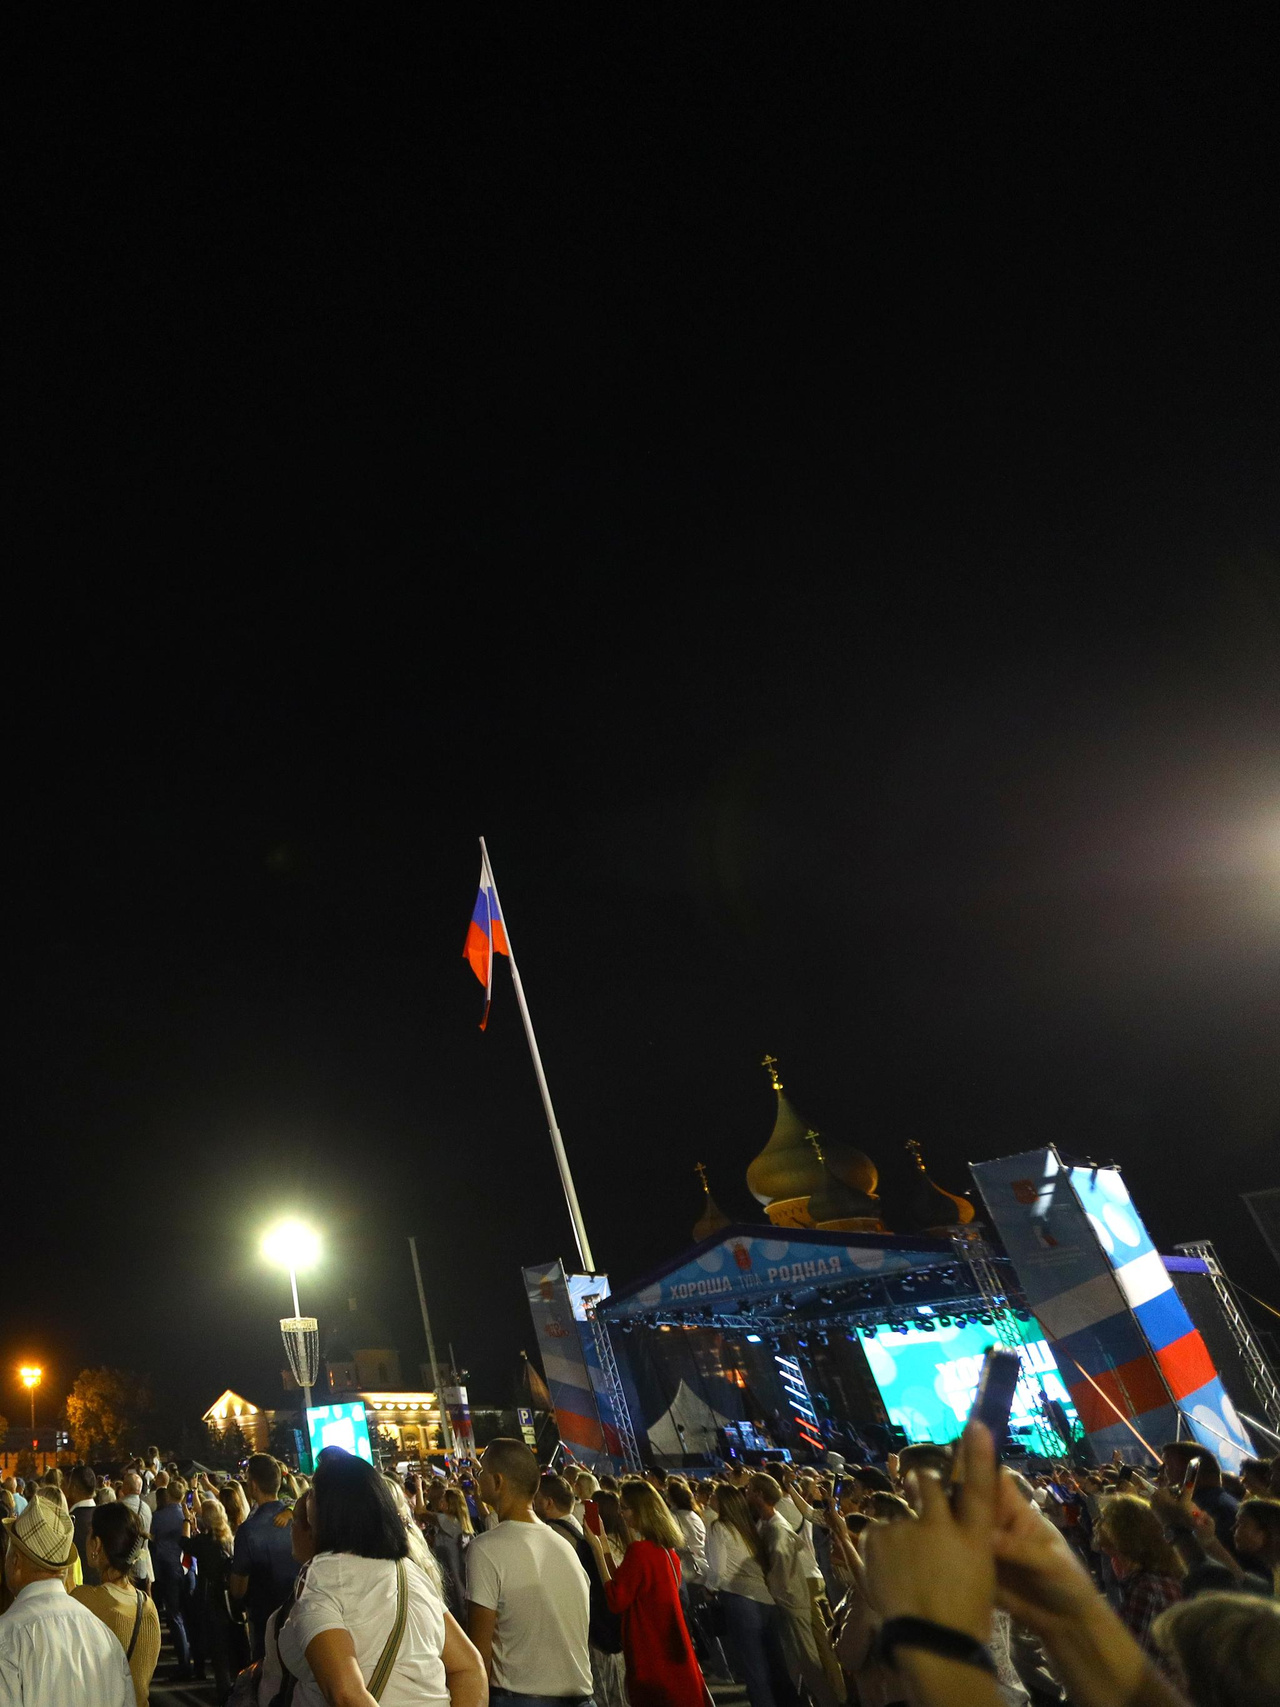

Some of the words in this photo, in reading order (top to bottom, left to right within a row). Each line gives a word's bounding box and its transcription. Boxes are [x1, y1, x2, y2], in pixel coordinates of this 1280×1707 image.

[670, 1275, 733, 1300] ХОРОША
[767, 1256, 841, 1284] РОДНАЯ
[521, 1410, 529, 1424] P
